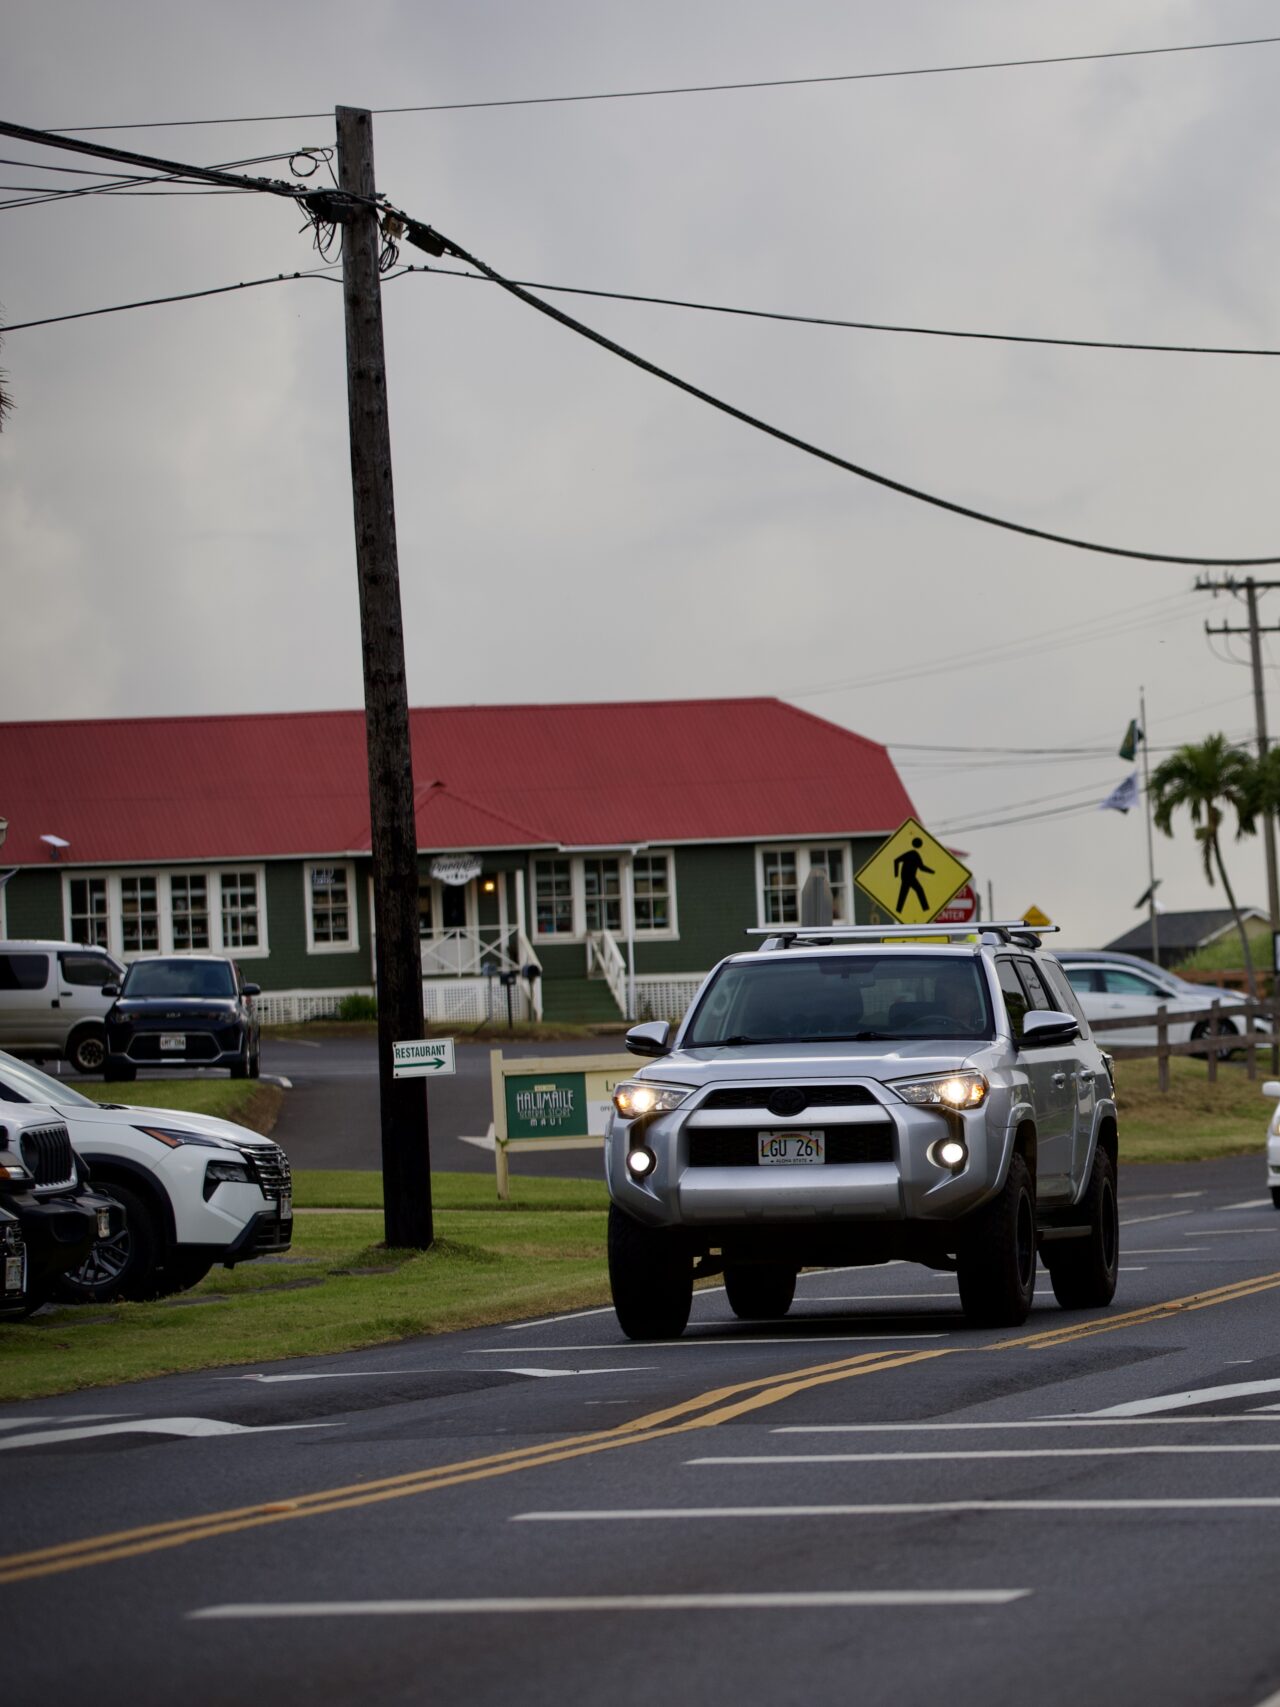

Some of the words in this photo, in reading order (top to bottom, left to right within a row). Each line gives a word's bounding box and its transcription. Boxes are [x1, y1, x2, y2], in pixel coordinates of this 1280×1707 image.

[395, 1044, 446, 1059] RESTAURANT
[762, 1140, 787, 1157] LGU
[797, 1139, 819, 1156] 261
